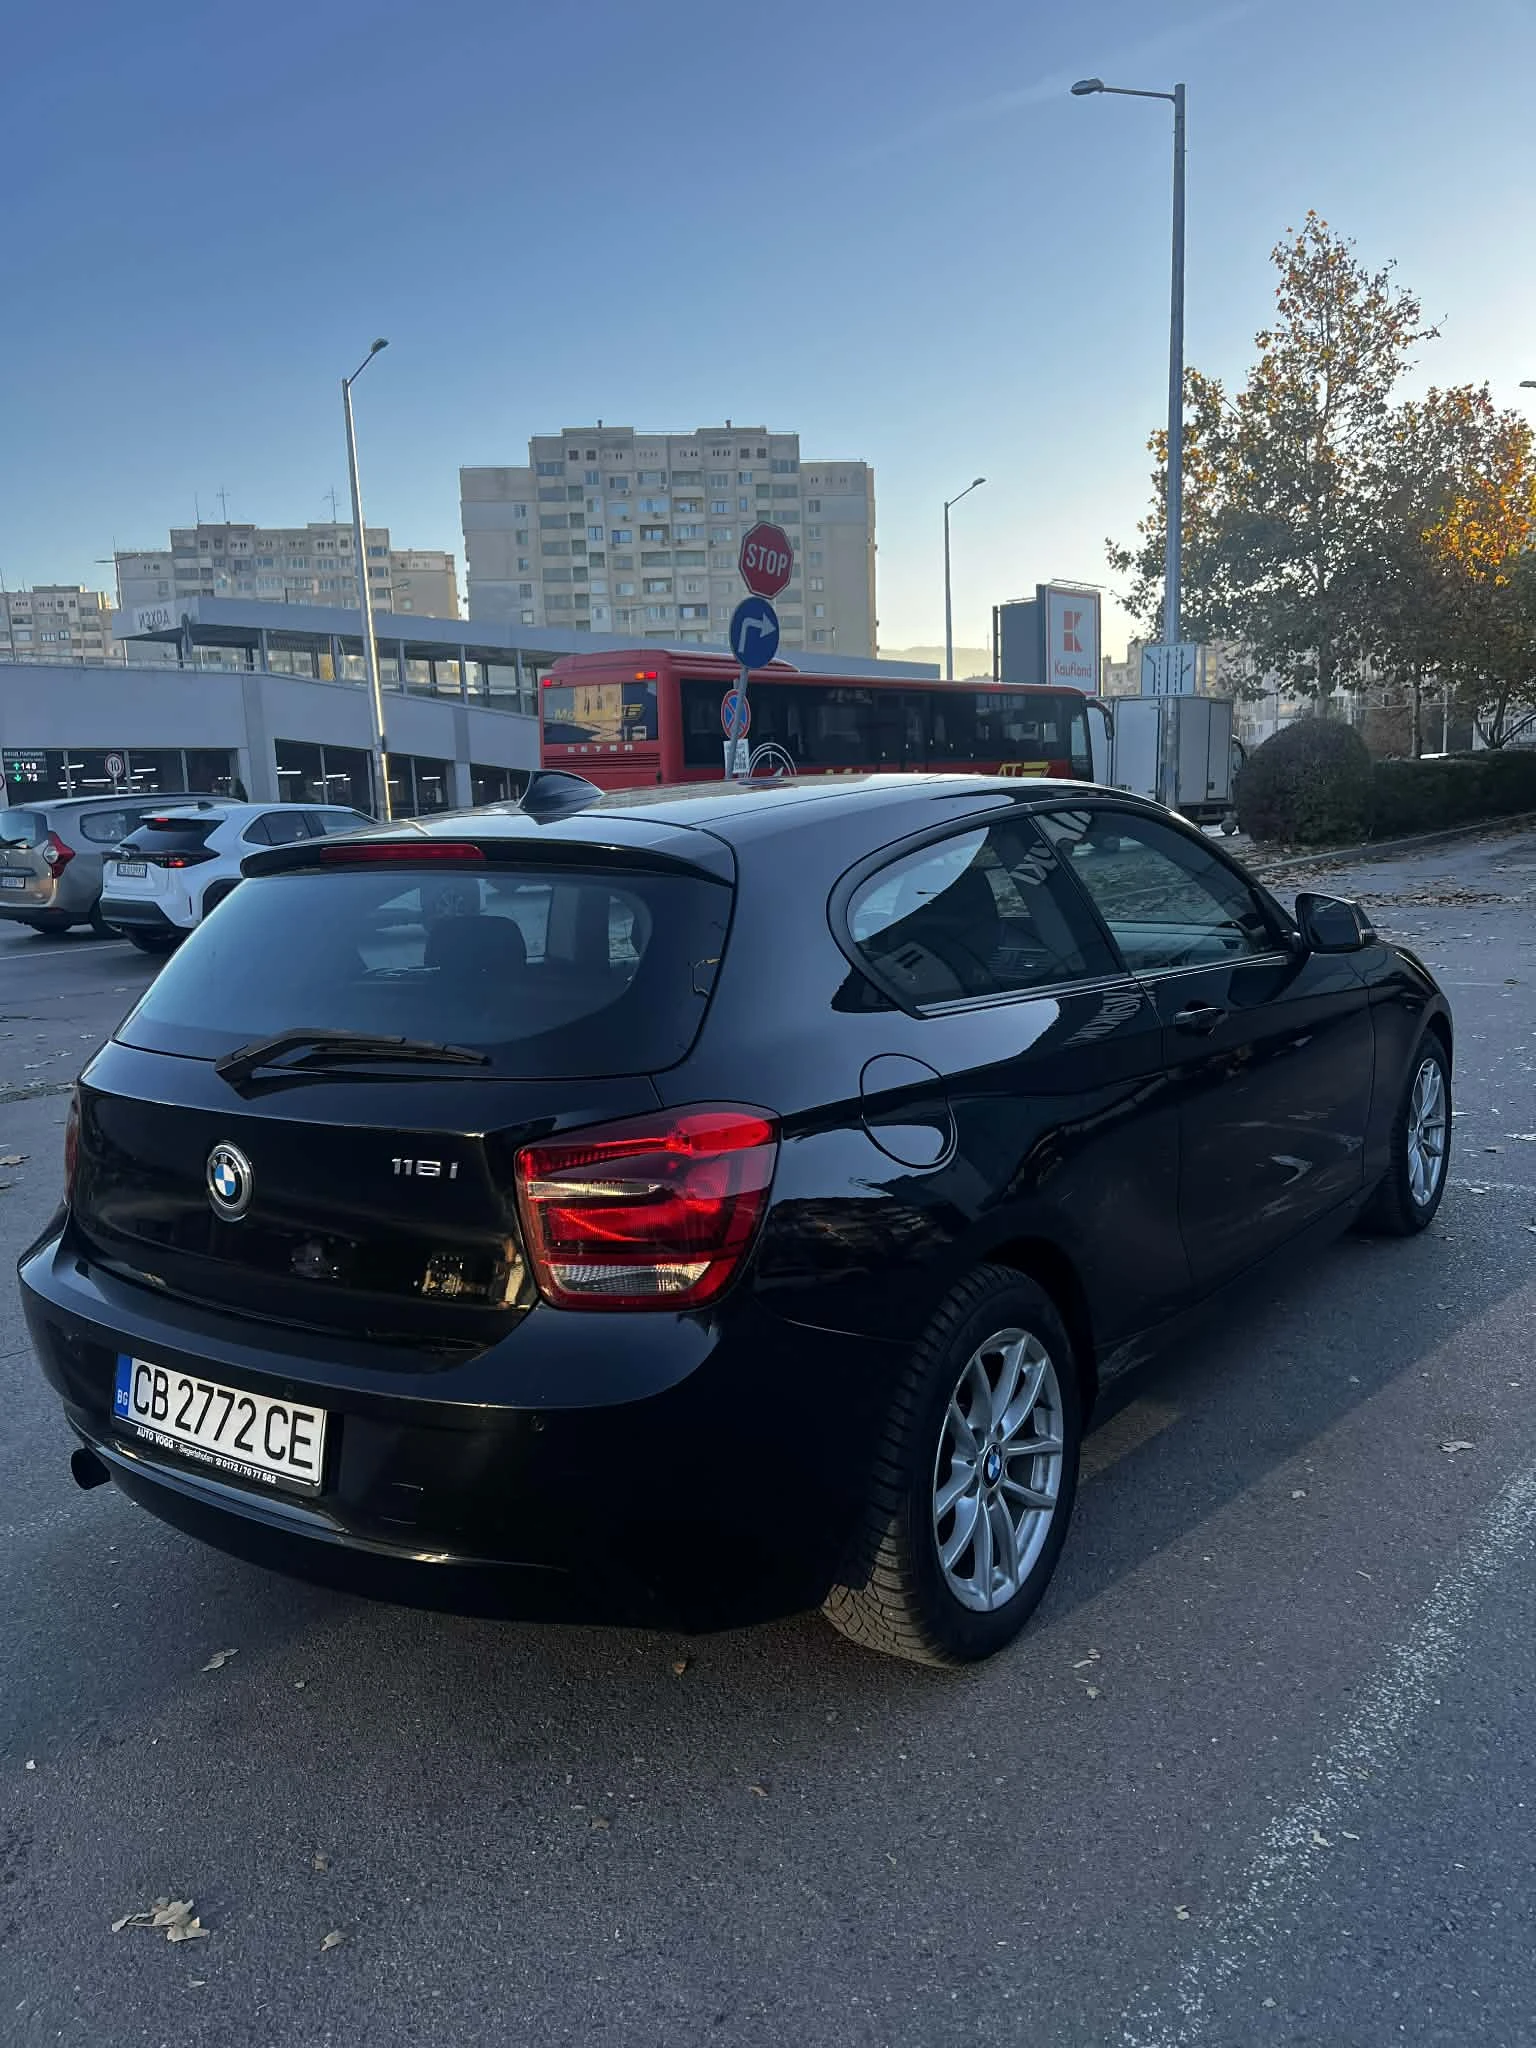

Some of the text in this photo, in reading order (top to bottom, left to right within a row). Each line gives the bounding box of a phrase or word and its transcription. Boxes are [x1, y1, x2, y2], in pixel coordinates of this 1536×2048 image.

[745, 543, 788, 577] STOP
[138, 608, 170, 630] ИЗХОД
[1054, 658, 1092, 679] Kaufland
[110, 758, 120, 772] 10
[116, 1388, 129, 1407] BG
[133, 1364, 317, 1470] CB 2772 CE
[136, 1426, 154, 1441] AUTO
[222, 1459, 239, 1472] 0172
